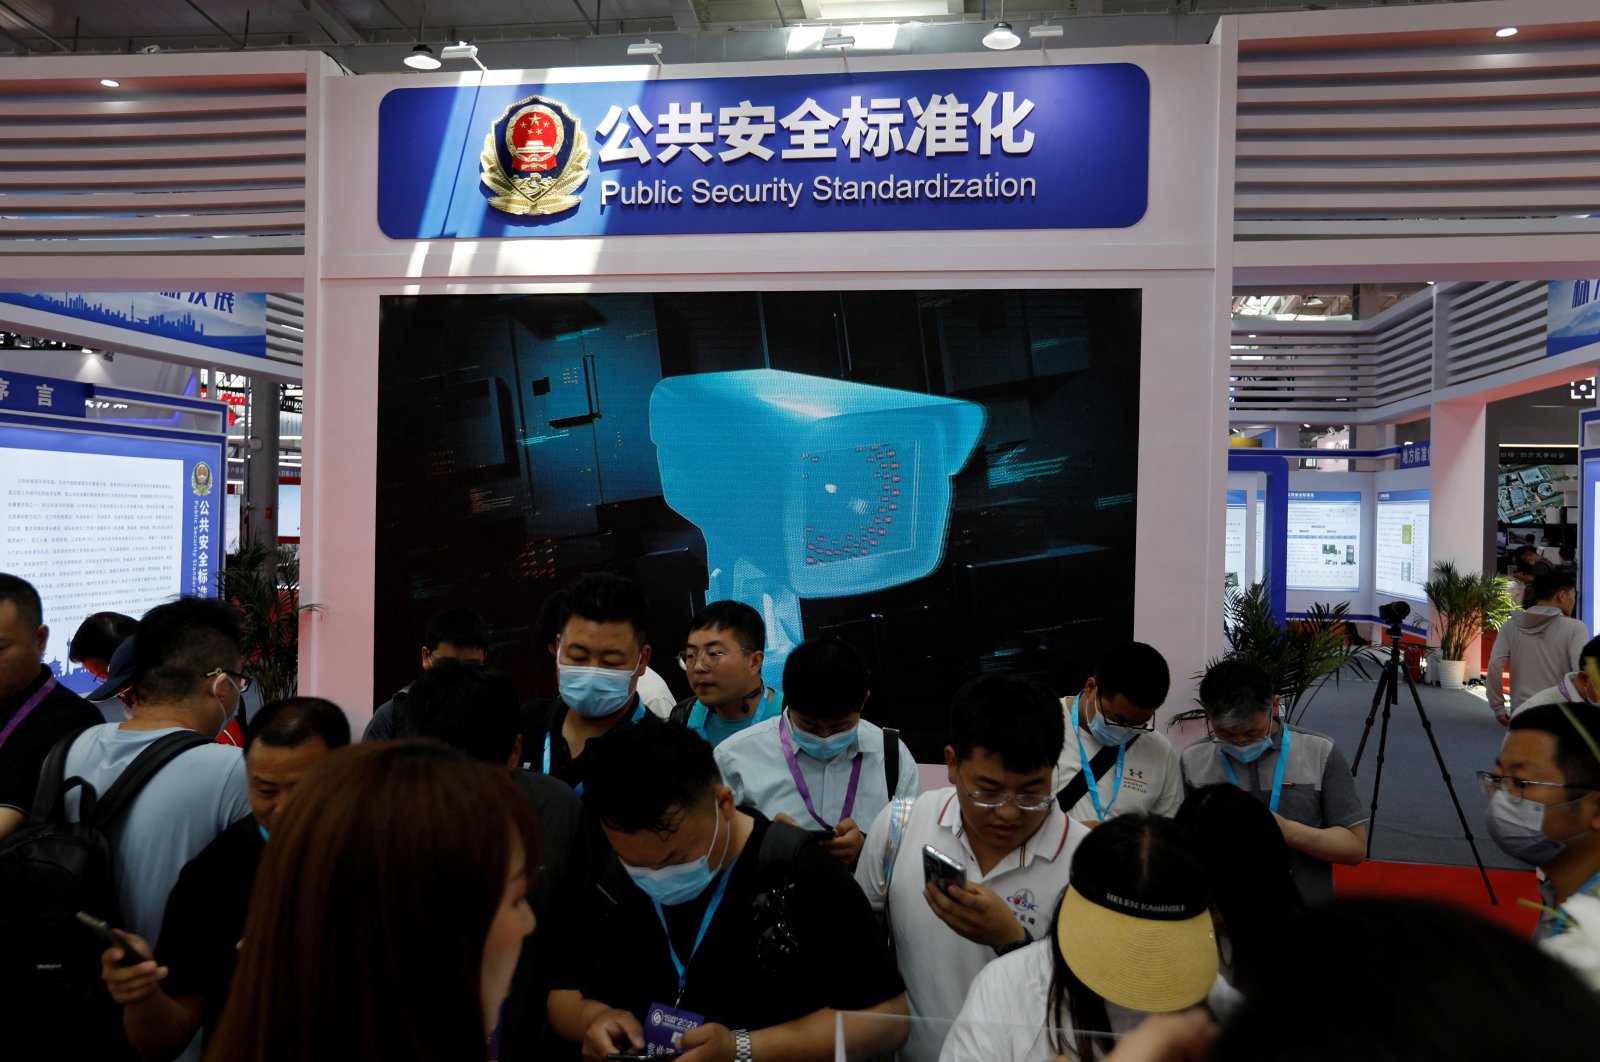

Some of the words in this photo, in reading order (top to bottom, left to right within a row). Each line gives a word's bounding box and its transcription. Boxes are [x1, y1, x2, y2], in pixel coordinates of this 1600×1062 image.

[596, 91, 1035, 165] 公共安全标准化
[601, 179, 683, 206] Public
[692, 177, 803, 208] Security
[813, 172, 1036, 201] Standardization
[1106, 892, 1139, 909] HELEN
[677, 1018, 698, 1028] 2023
